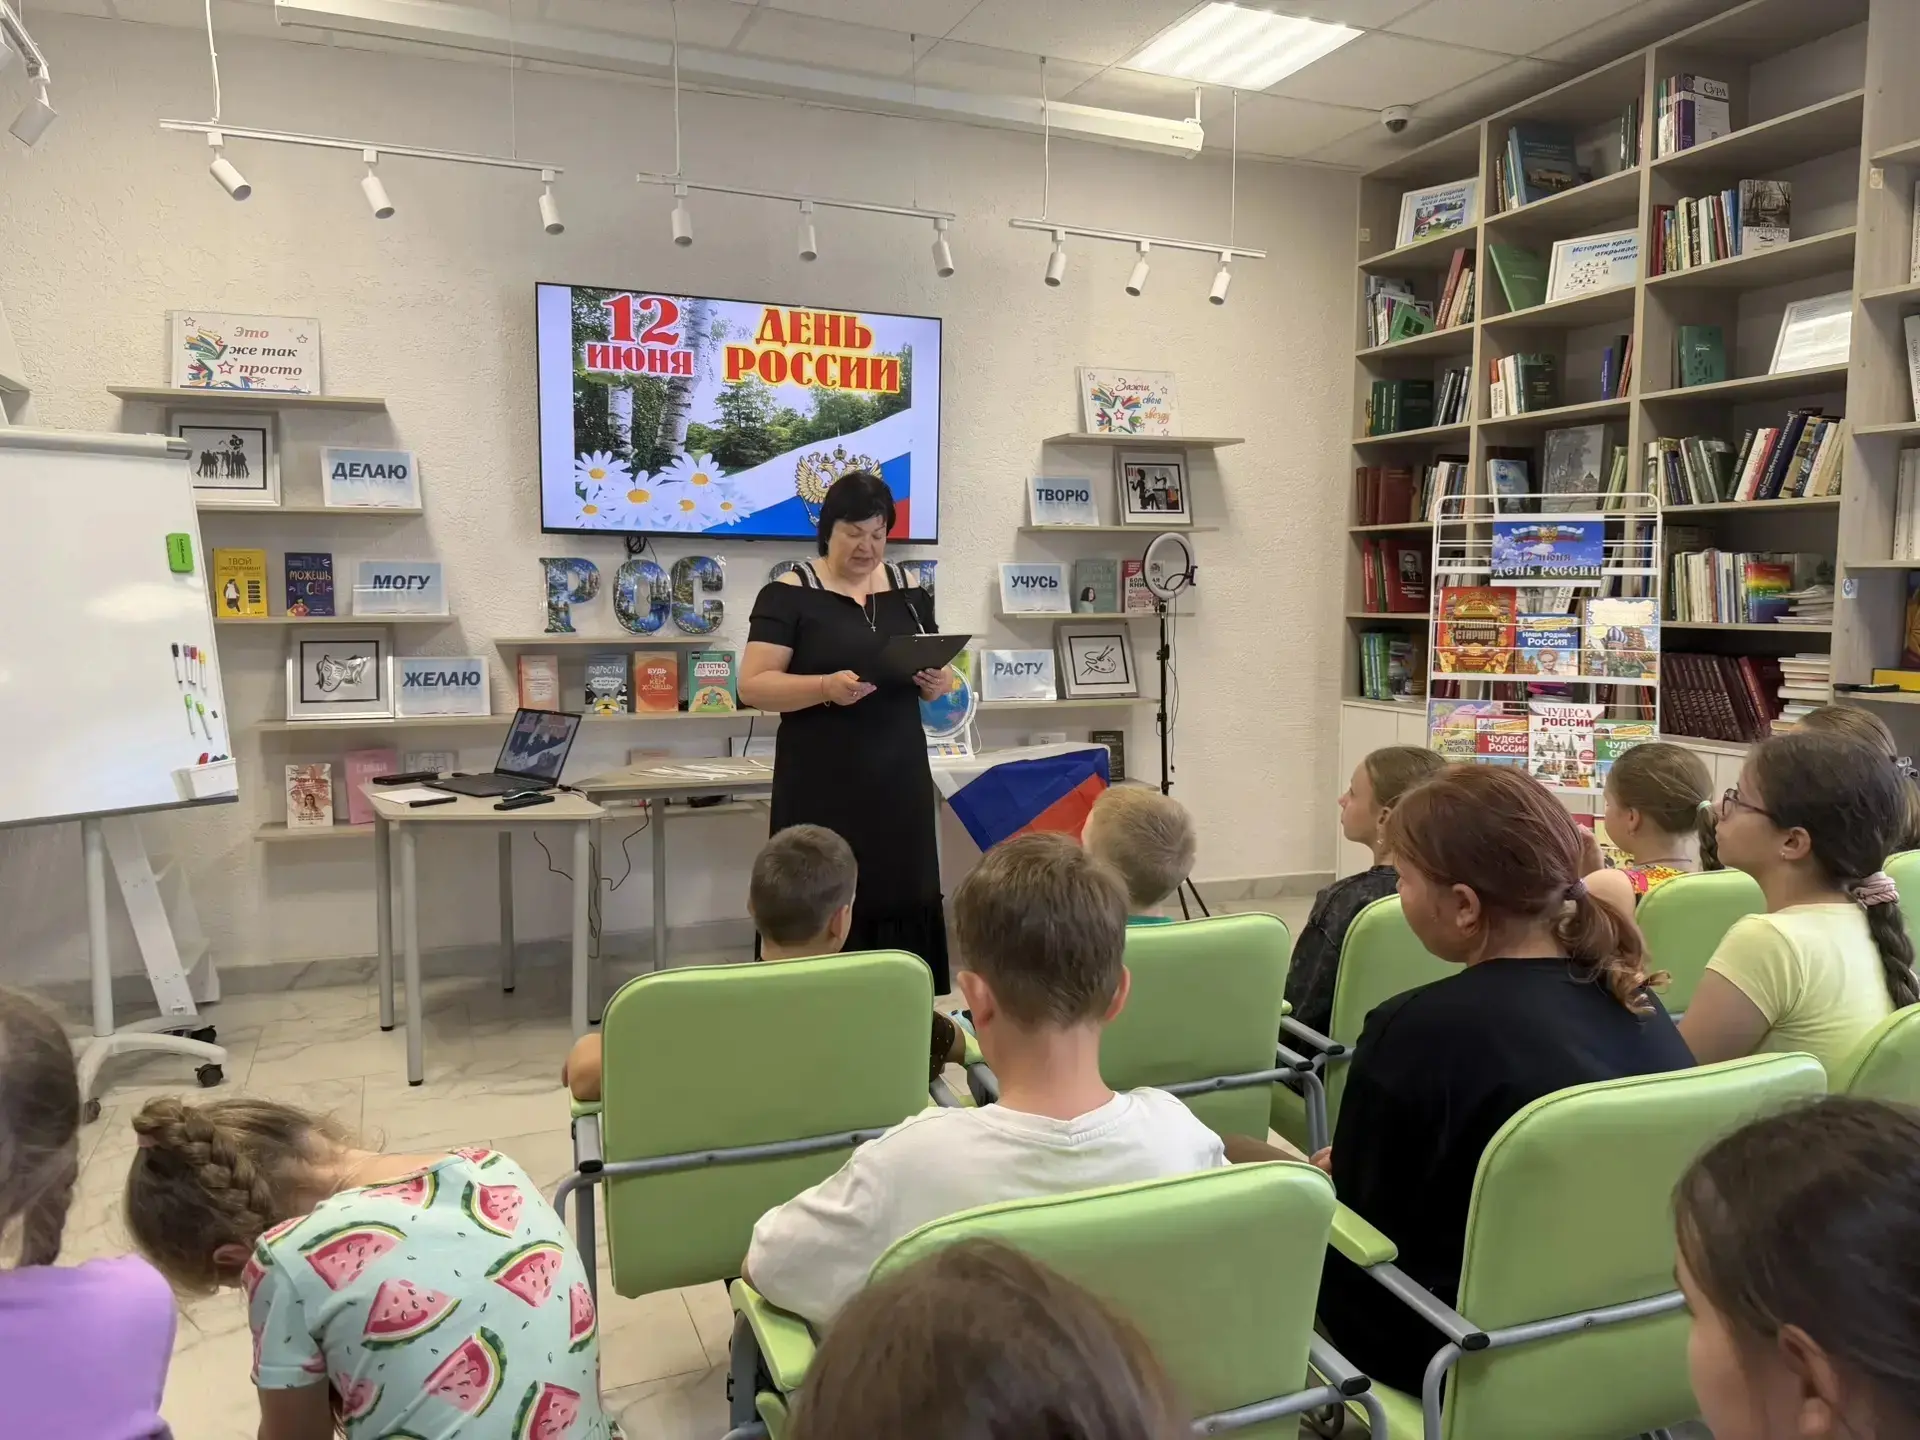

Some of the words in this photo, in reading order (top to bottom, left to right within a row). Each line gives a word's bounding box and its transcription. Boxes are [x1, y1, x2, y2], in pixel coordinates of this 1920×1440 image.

[1572, 243, 1610, 253] Историю
[603, 294, 680, 345] 12
[233, 326, 269, 338] Это
[755, 307, 872, 349] ДЕНЬ
[228, 346, 257, 355] же
[262, 347, 298, 357] так
[586, 345, 694, 376] ИЮНЯ
[238, 364, 302, 376] просто
[726, 346, 900, 392] РОССИИ
[1142, 392, 1162, 404] свою
[332, 462, 407, 480] ДЕЛАЮ
[1036, 488, 1090, 502] ТВОРЮ
[289, 571, 332, 580] МОЖЕШЬ
[373, 574, 430, 591] МОГУ
[1011, 575, 1059, 589] УЧУСЬ
[994, 661, 1044, 676] РАСТУ
[402, 671, 481, 687] ЖЕЛАЮ
[1543, 707, 1592, 719] ЧУДЕСА
[1541, 717, 1594, 727] РОССИИ
